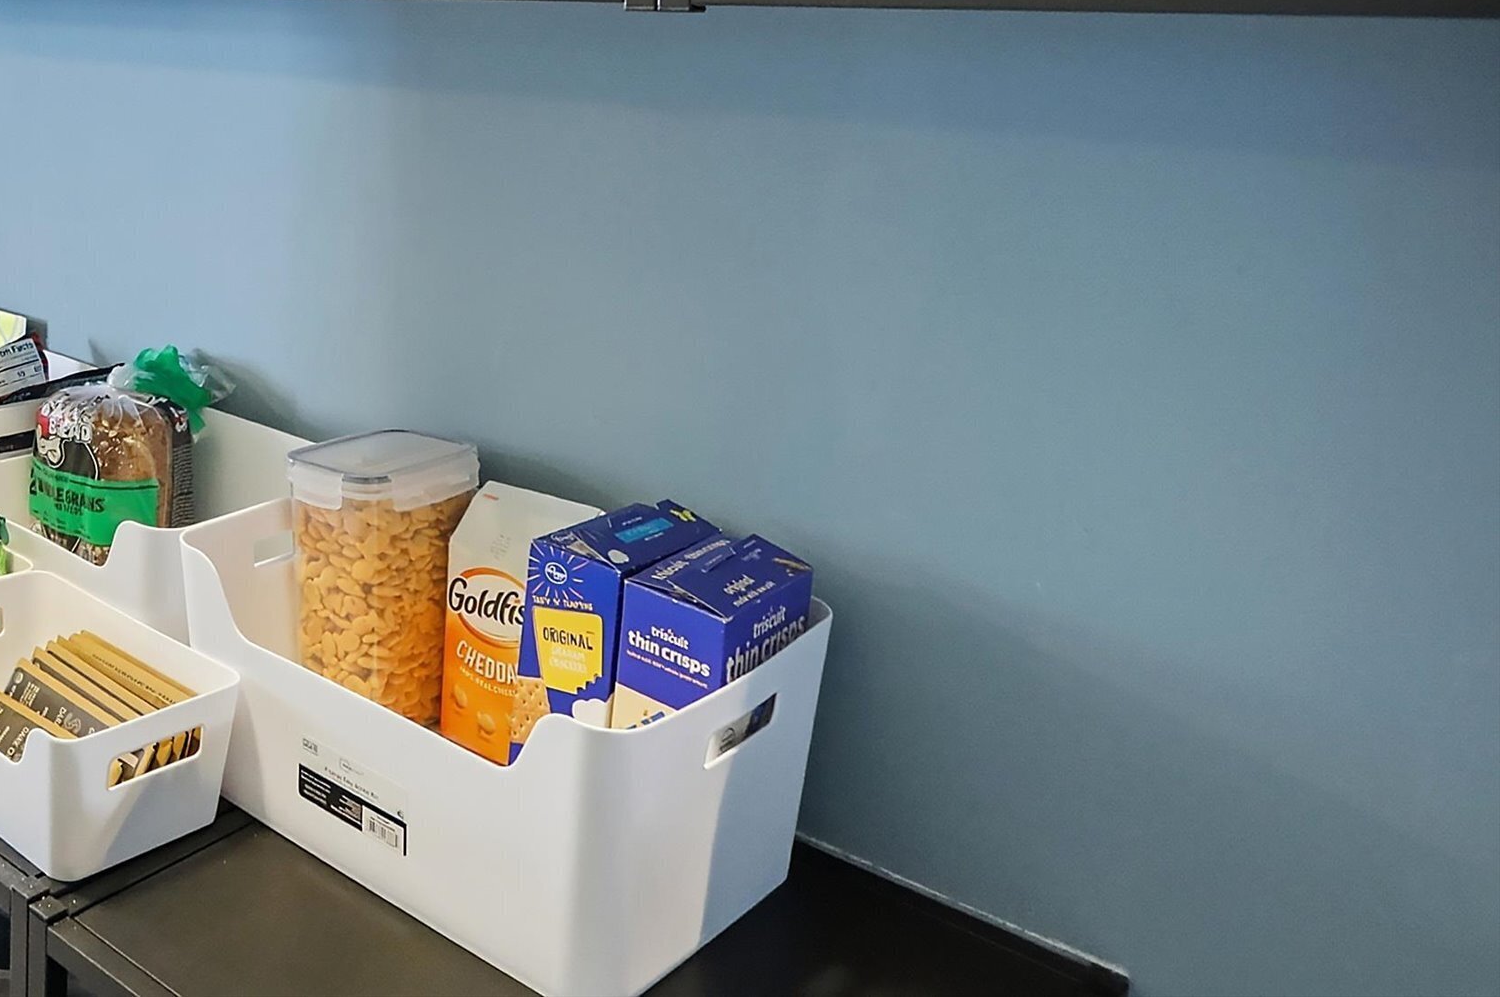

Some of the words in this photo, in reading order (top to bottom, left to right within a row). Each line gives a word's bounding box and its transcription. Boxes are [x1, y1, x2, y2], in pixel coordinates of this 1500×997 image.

[11, 341, 35, 355] Facts
[448, 576, 525, 627] Goldfis
[752, 604, 787, 639] triscuit
[542, 626, 594, 651] ORIGINAL
[627, 630, 660, 657] thin
[660, 647, 711, 678] crisps
[651, 625, 690, 651] triscuit
[725, 640, 760, 684] thin
[761, 614, 806, 663] crisps
[456, 639, 518, 686] CHEDDA
